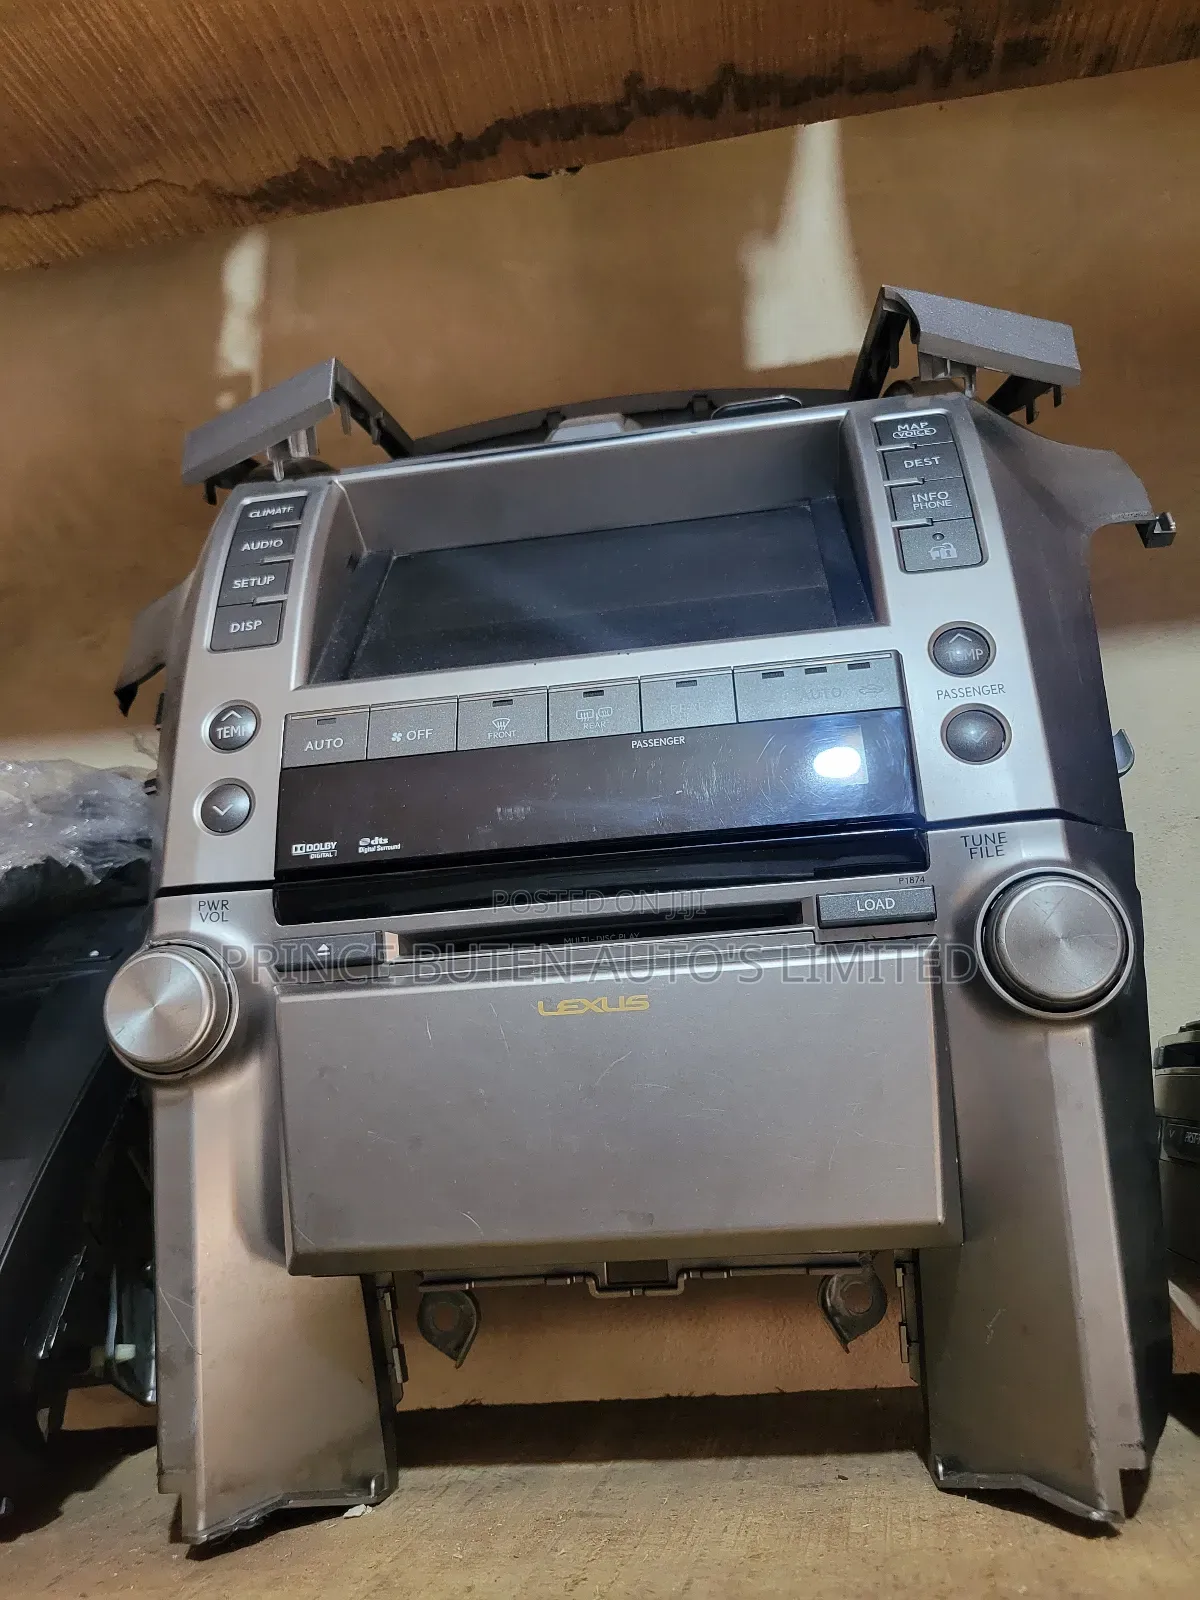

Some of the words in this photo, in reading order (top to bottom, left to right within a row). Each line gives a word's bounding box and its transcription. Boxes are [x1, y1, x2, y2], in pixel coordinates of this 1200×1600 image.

[897, 421, 929, 432] MAP
[903, 456, 941, 469] DEST
[911, 491, 949, 502] INFO
[248, 506, 295, 518] CLIMATE
[913, 500, 953, 511] PHONE
[241, 538, 284, 552] AUDIO
[232, 574, 276, 589] SETUP
[230, 619, 263, 634] DISP
[937, 684, 1006, 701] PASSENGER
[583, 720, 607, 731] REAR
[406, 728, 434, 742] OFF
[487, 729, 517, 740] FRONT
[304, 737, 344, 752] AUTO
[631, 736, 686, 749] PASSENGER
[370, 837, 389, 845] dts
[960, 831, 1008, 848] TUNE
[306, 842, 338, 852] DOLBY
[358, 845, 377, 854] Digital
[376, 843, 401, 853] Surround
[969, 845, 1006, 860] FILE
[898, 875, 926, 885] P1874
[198, 899, 229, 912] PWR
[856, 897, 896, 912] LOAD
[199, 910, 229, 923] VOL
[537, 994, 650, 1017] LEXUS
